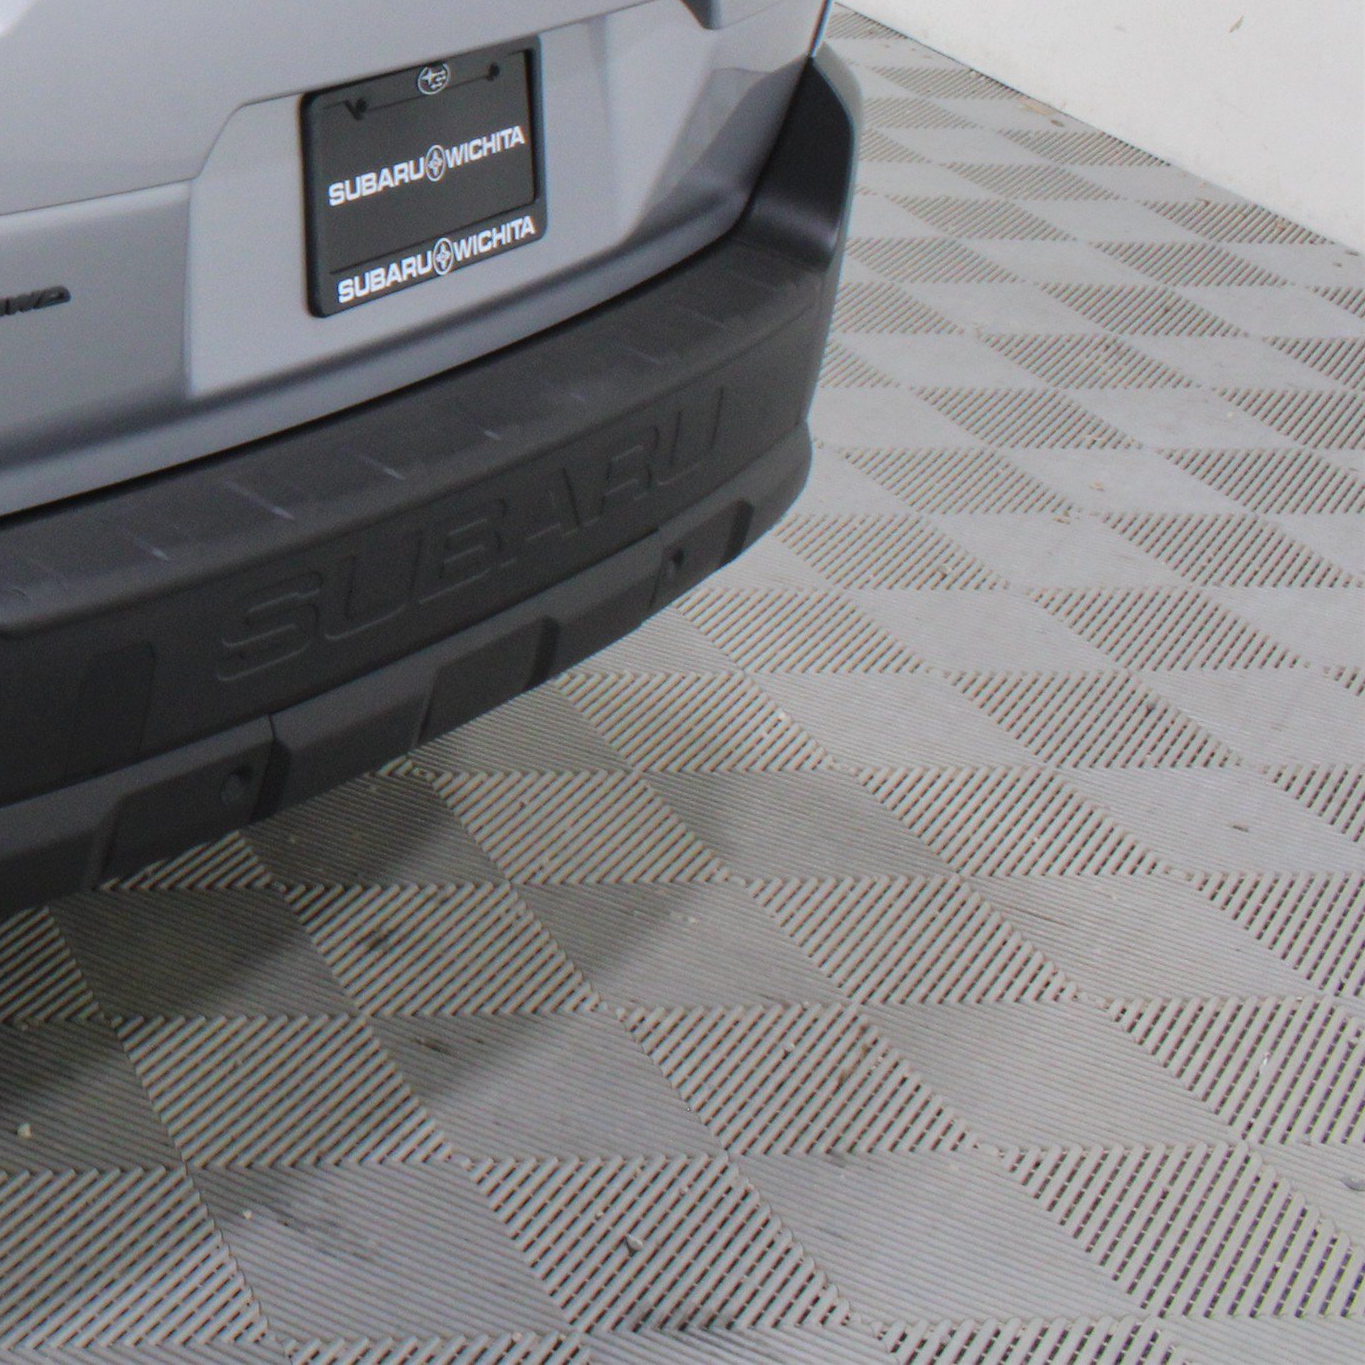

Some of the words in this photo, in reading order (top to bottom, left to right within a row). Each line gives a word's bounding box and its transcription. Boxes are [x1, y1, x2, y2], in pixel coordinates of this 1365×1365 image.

[327, 160, 425, 207] SUBARU
[444, 125, 526, 169] WICHITA
[337, 251, 434, 304] SUBARU
[453, 215, 537, 261] WICHITA
[216, 387, 728, 683] SUBARU
